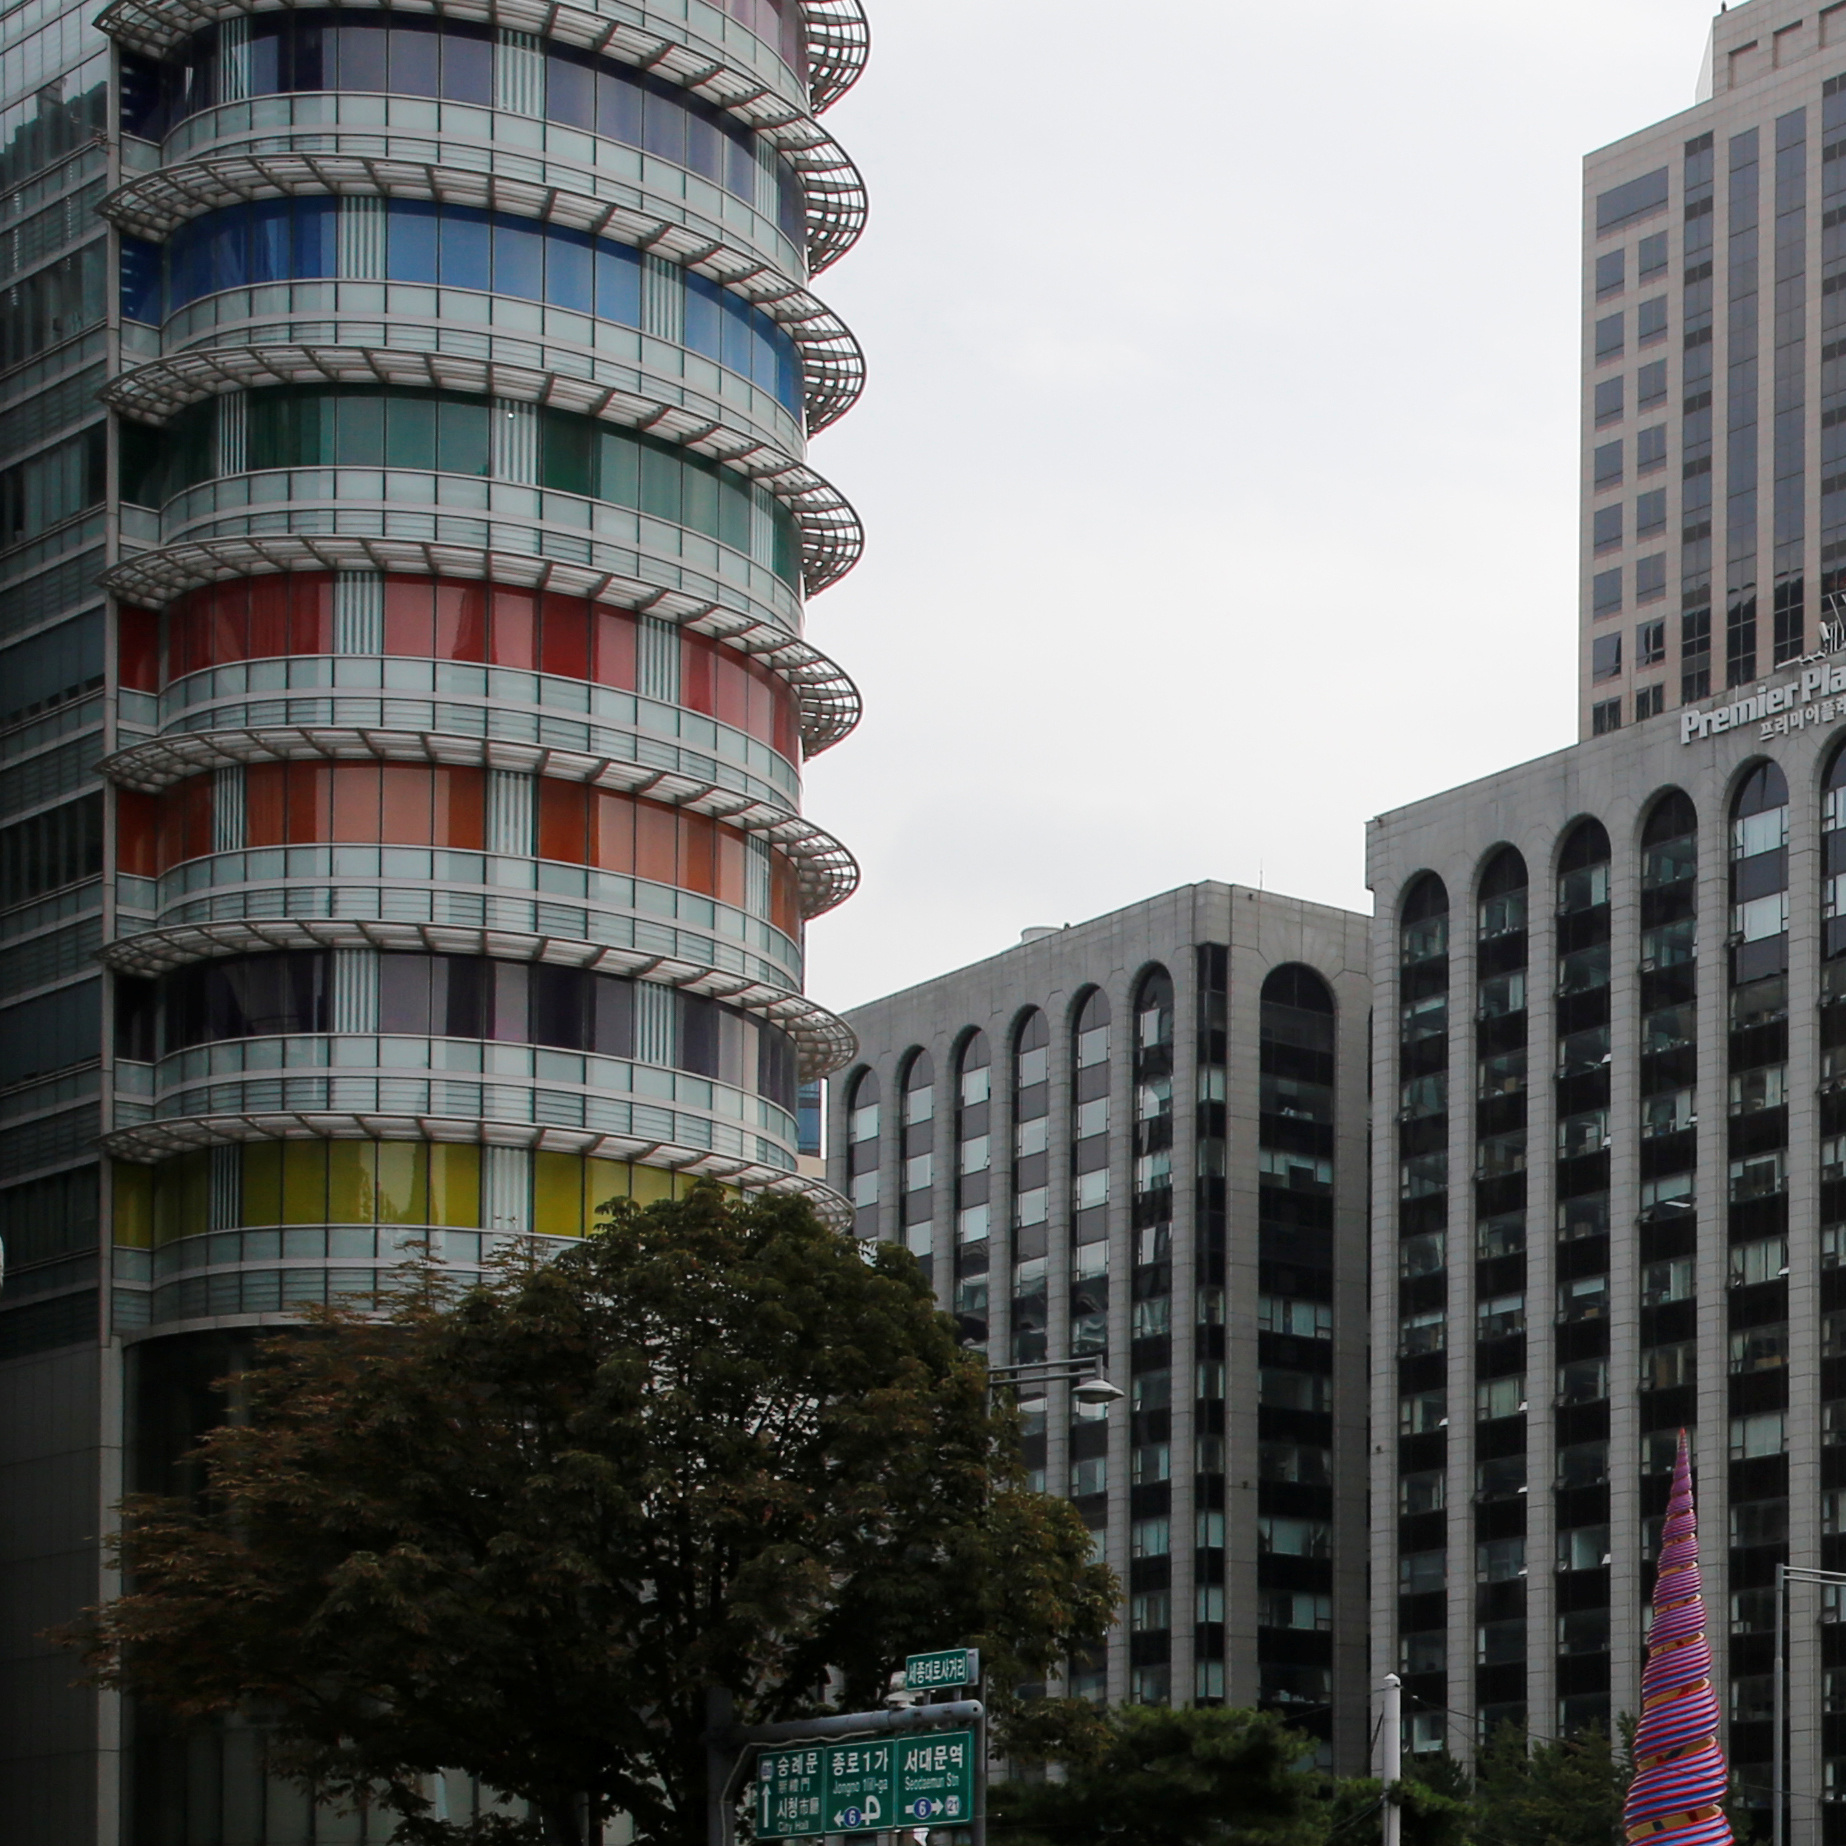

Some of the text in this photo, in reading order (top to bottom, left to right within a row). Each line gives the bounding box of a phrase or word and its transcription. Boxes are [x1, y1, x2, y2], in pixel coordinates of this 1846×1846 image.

[1681, 682, 1799, 744] Premier
[907, 1656, 966, 1684] 세종대로사거리
[777, 1752, 818, 1777] 숭례문
[904, 1743, 963, 1773] 서대문역
[833, 1780, 860, 1796] Jongno
[777, 1797, 798, 1819] 시청
[848, 1810, 856, 1824] 6
[919, 1801, 927, 1816] 6
